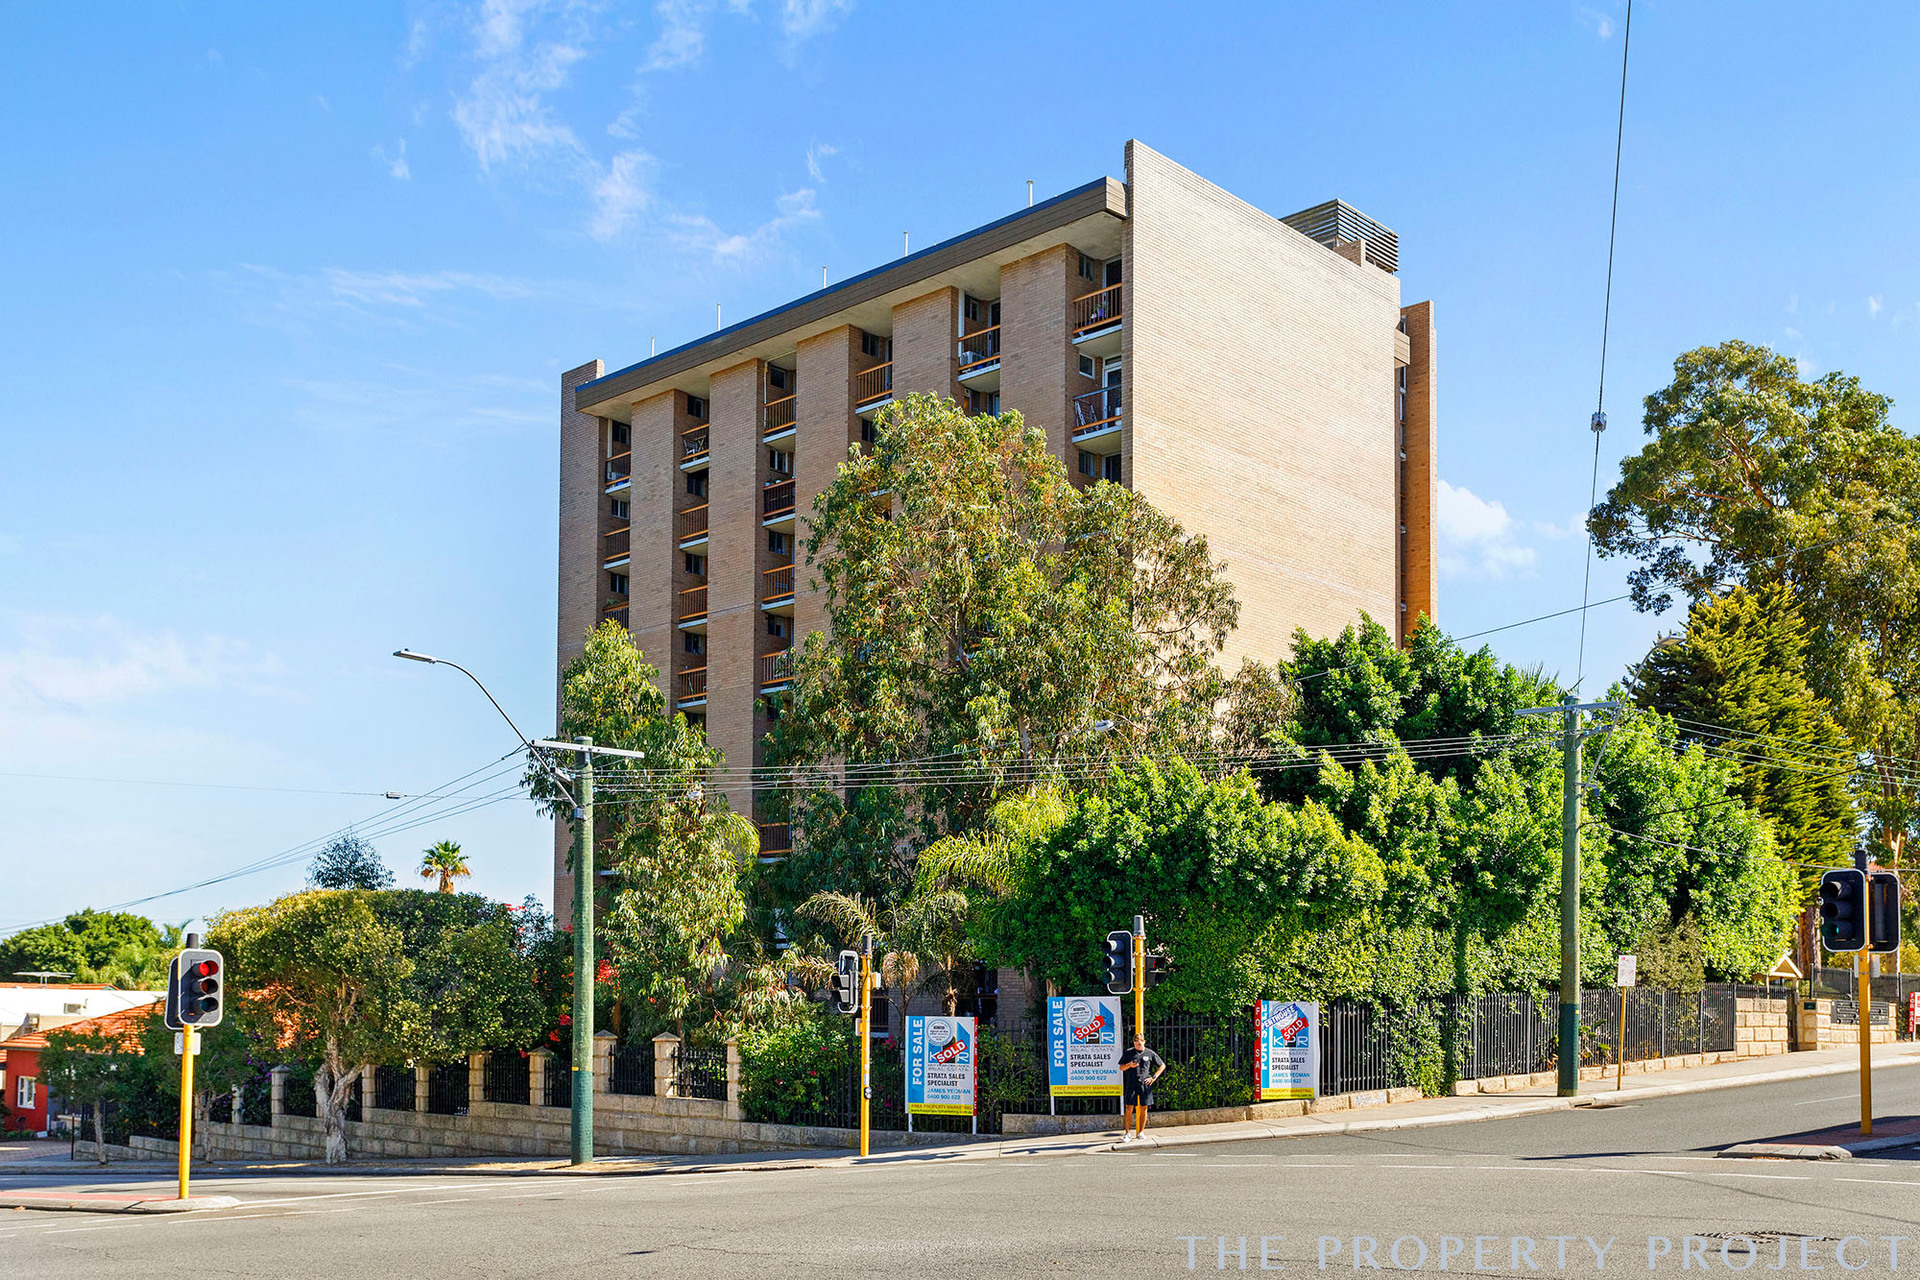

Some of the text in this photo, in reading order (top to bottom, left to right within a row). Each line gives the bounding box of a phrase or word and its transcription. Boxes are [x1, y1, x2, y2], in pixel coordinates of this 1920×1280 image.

[1052, 1000, 1065, 1068] FOR SALE
[1071, 1032, 1114, 1043] KPR
[1076, 1020, 1101, 1038] SOLD
[1283, 1020, 1303, 1040] SOLD
[912, 1019, 923, 1085] FOR SALE
[929, 1051, 969, 1063] KR
[936, 1041, 966, 1063] SOLD
